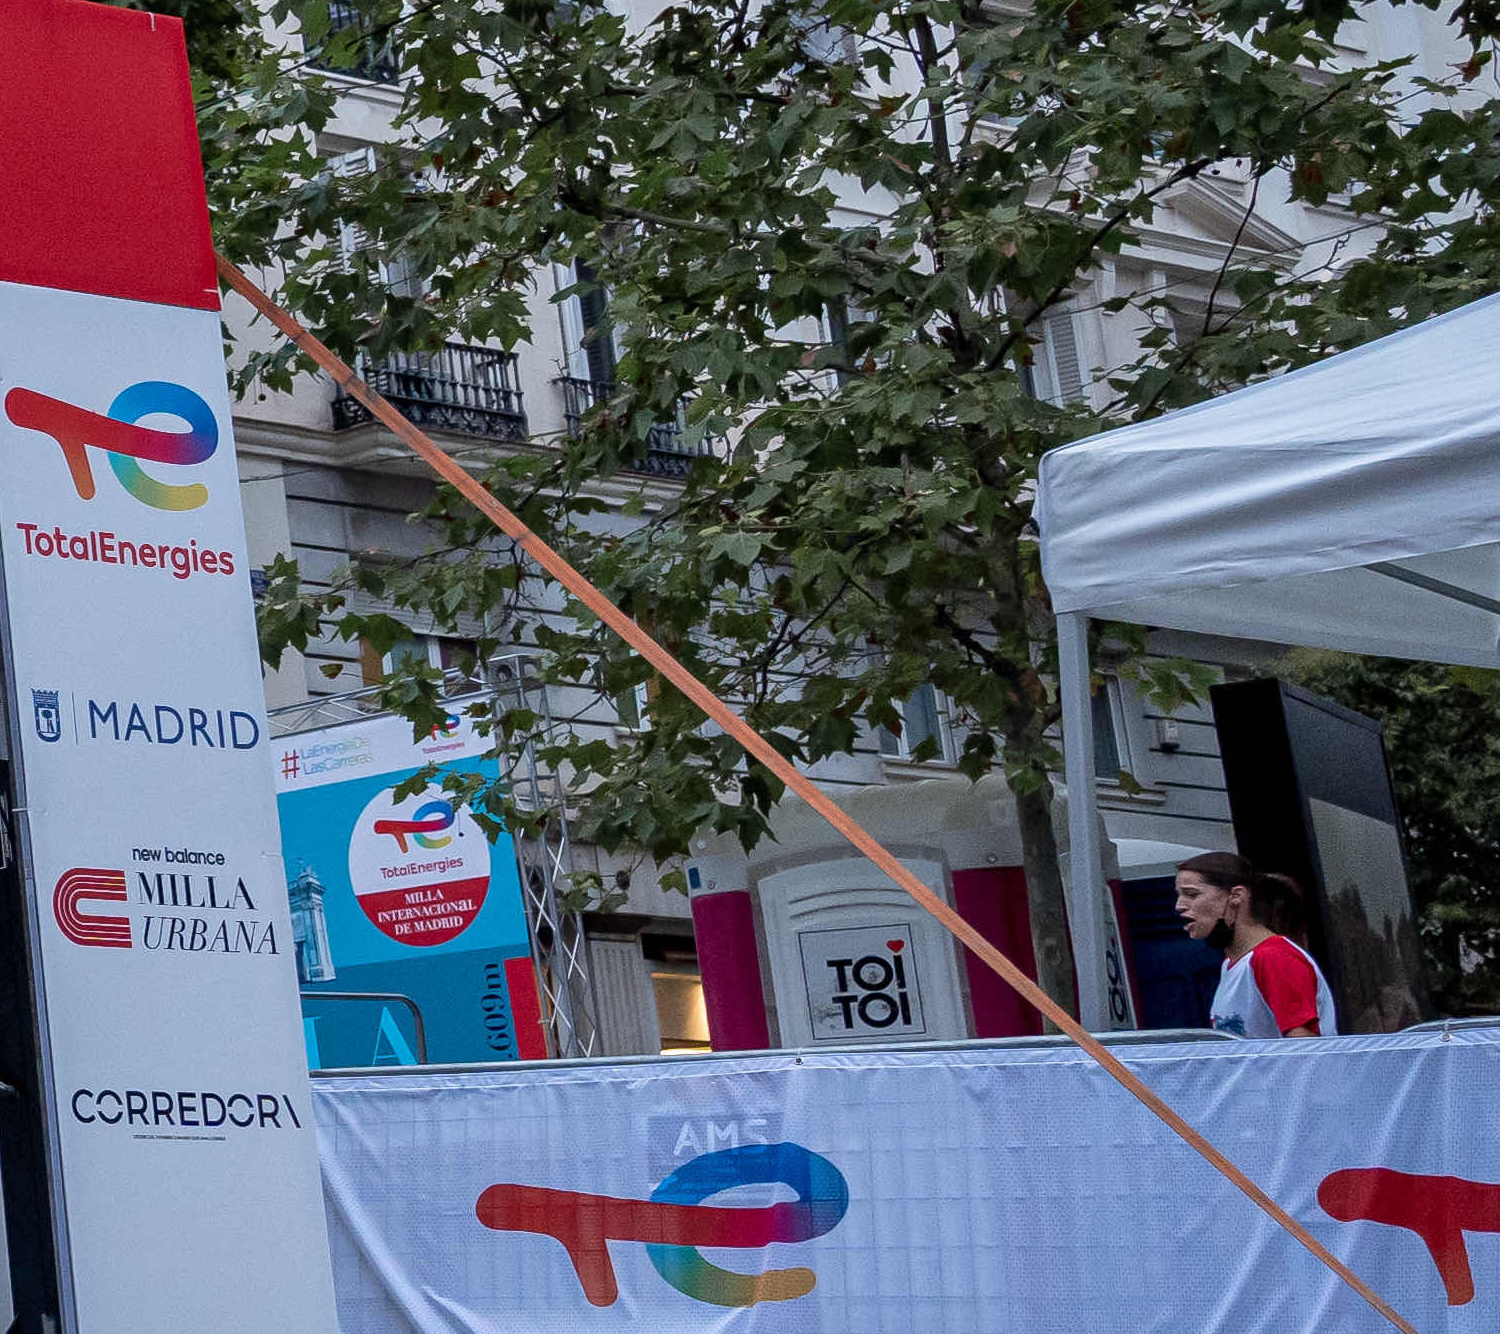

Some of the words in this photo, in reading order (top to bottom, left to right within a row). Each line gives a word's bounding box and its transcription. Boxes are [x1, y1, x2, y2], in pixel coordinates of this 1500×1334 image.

[16, 521, 235, 580] TotalEnergies
[89, 699, 259, 750] MADRID
[132, 846, 162, 863] new
[165, 846, 225, 867] balance
[380, 856, 463, 879] TotalEnergies
[136, 871, 259, 910] MILLA
[405, 888, 444, 905] MILLA
[142, 916, 280, 956] URBANA
[394, 922, 411, 935] DE
[414, 915, 463, 934] MADRID
[832, 989, 911, 1030] TOI
